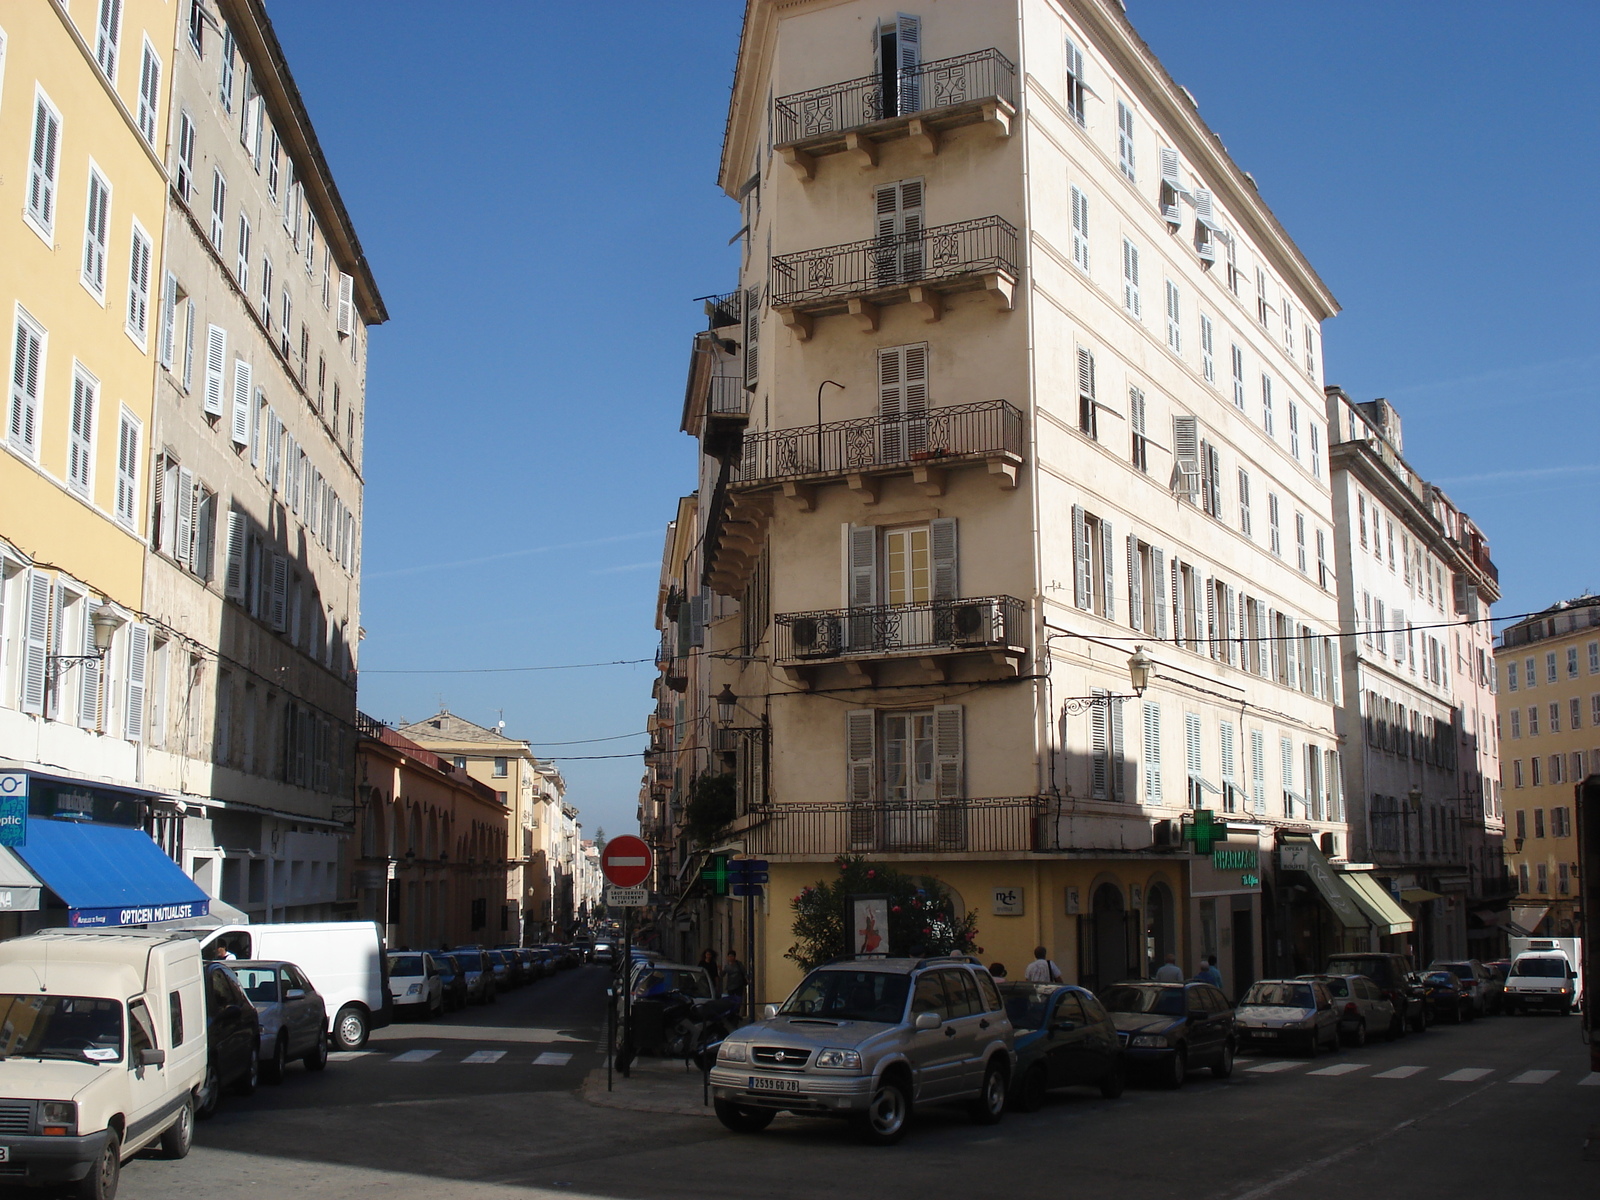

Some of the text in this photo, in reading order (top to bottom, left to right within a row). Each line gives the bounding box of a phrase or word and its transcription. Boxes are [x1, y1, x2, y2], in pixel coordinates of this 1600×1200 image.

[0, 815, 22, 826] ptic
[120, 907, 153, 925] OPTICIEN
[154, 904, 192, 921] MUTUALISTE
[755, 1079, 774, 1089] 2539
